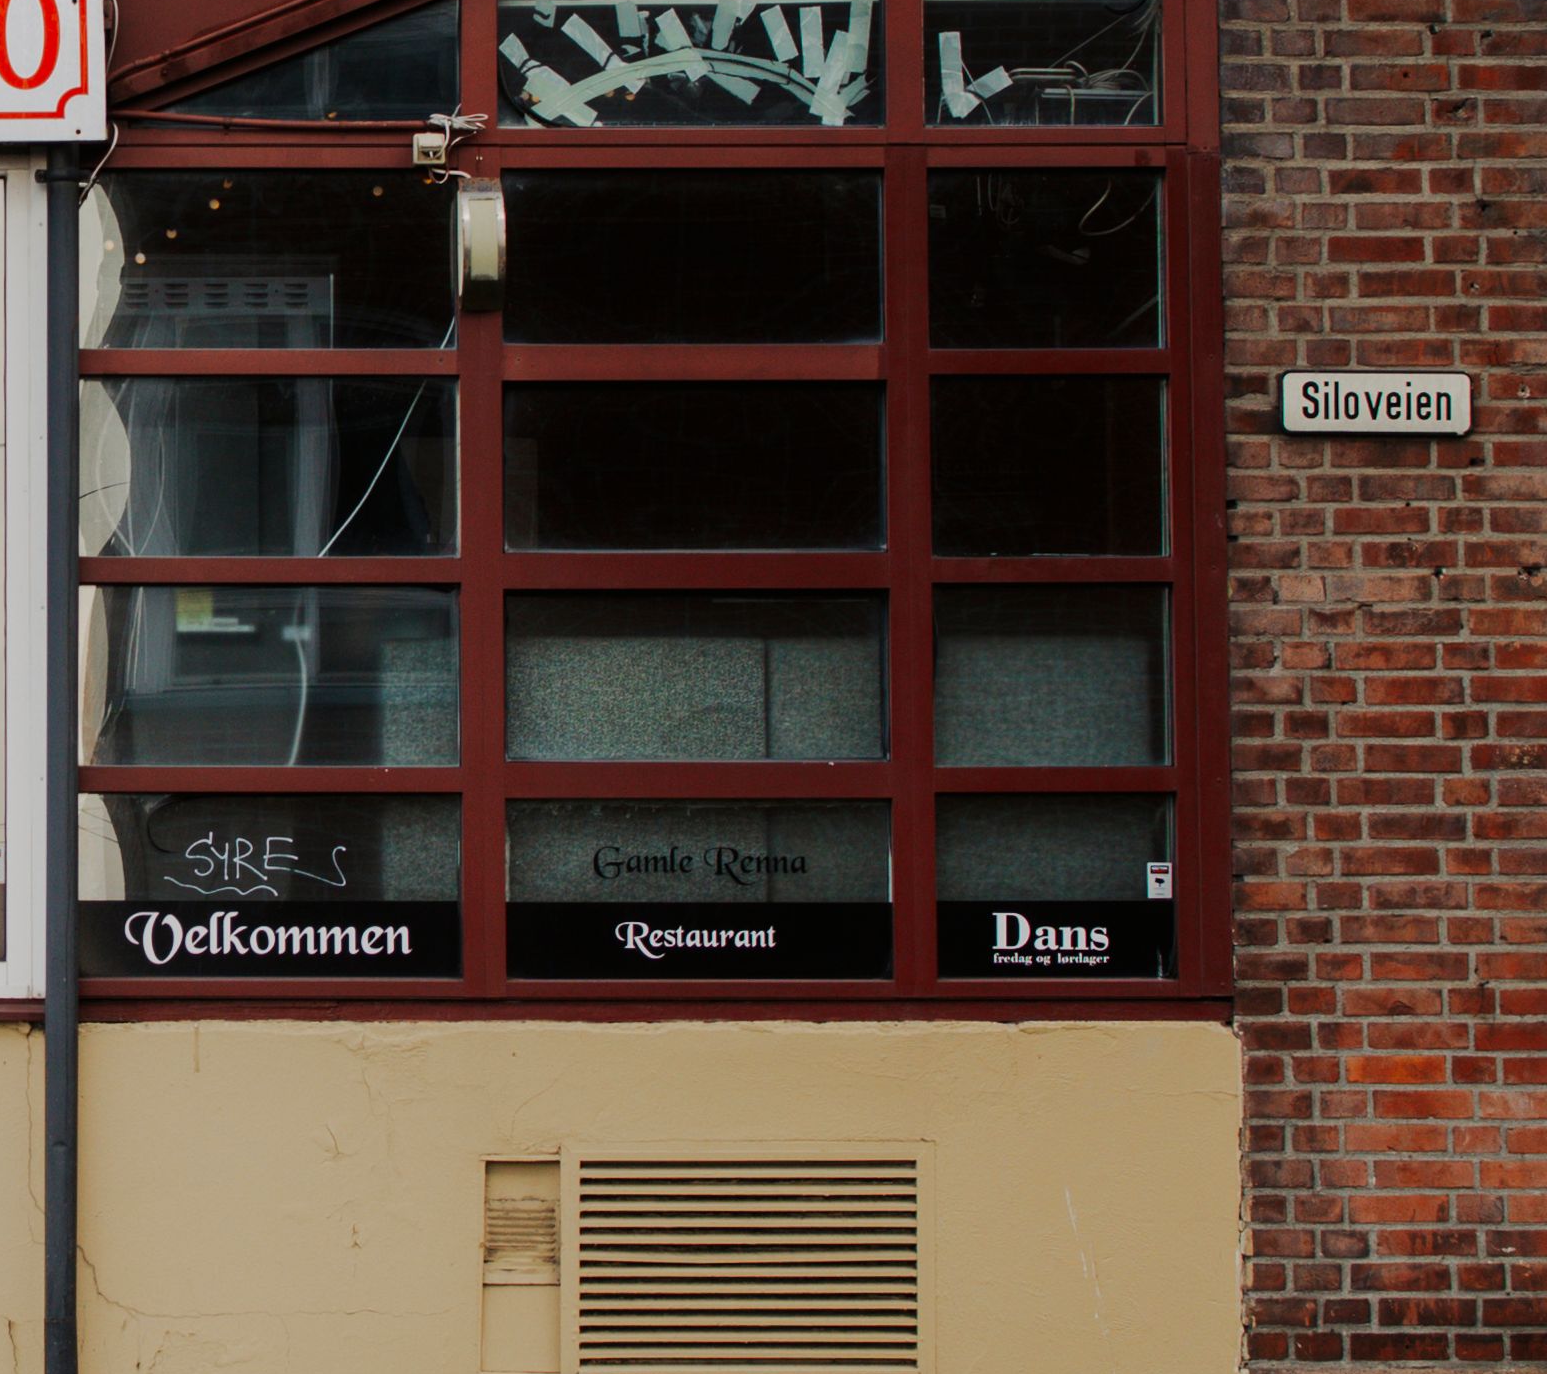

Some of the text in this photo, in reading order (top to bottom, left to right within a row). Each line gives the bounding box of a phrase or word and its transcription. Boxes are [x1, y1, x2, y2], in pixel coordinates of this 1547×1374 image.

[1301, 380, 1452, 421] Siloveien
[592, 845, 694, 880] Gamle
[123, 910, 413, 965] Velkommen
[614, 921, 777, 959] Restaurant
[992, 912, 1110, 951] Dans
[992, 953, 1110, 966] fredag og lørdager
